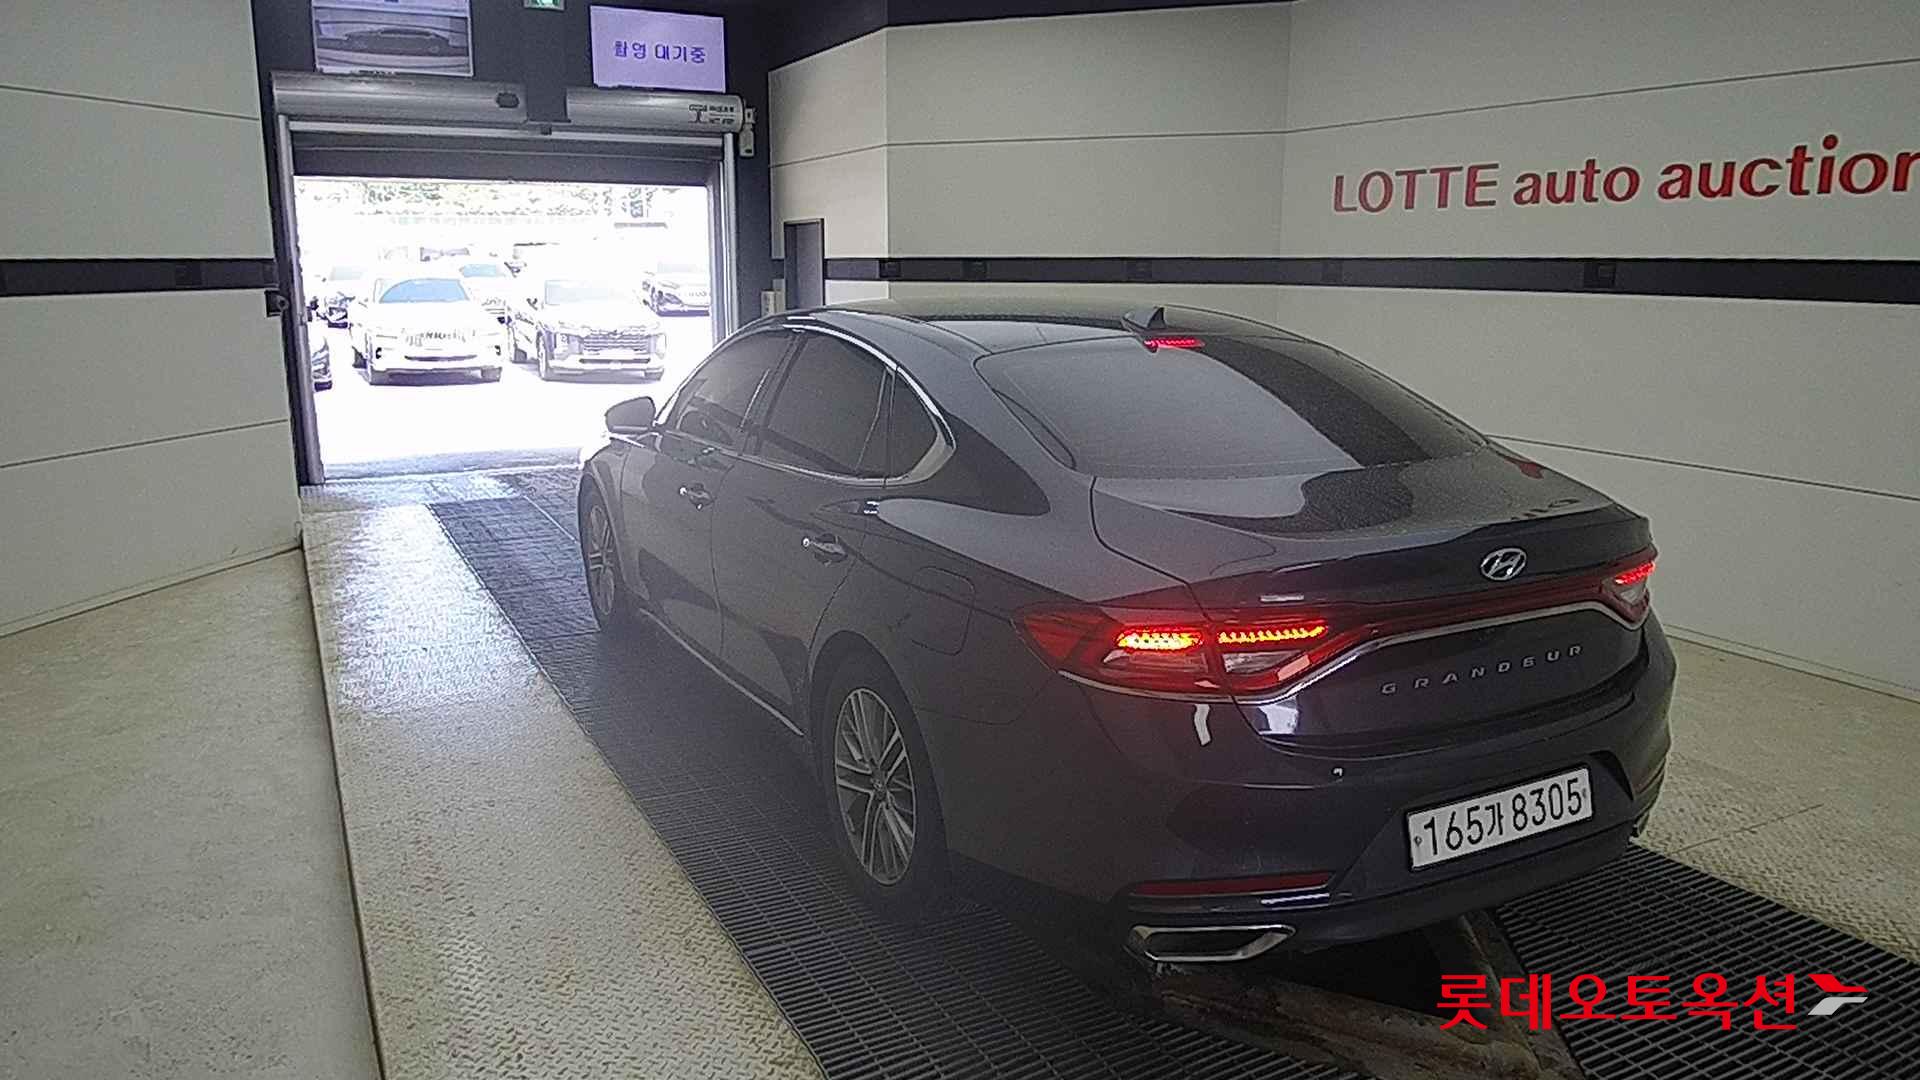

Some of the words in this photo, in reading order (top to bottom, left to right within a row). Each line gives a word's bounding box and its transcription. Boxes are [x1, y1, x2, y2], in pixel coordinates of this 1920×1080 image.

[654, 43, 706, 64] 대기중
[1333, 163, 1500, 213] LOTTE
[1513, 158, 1640, 206] auto
[1380, 644, 1583, 695] GRANDEUR
